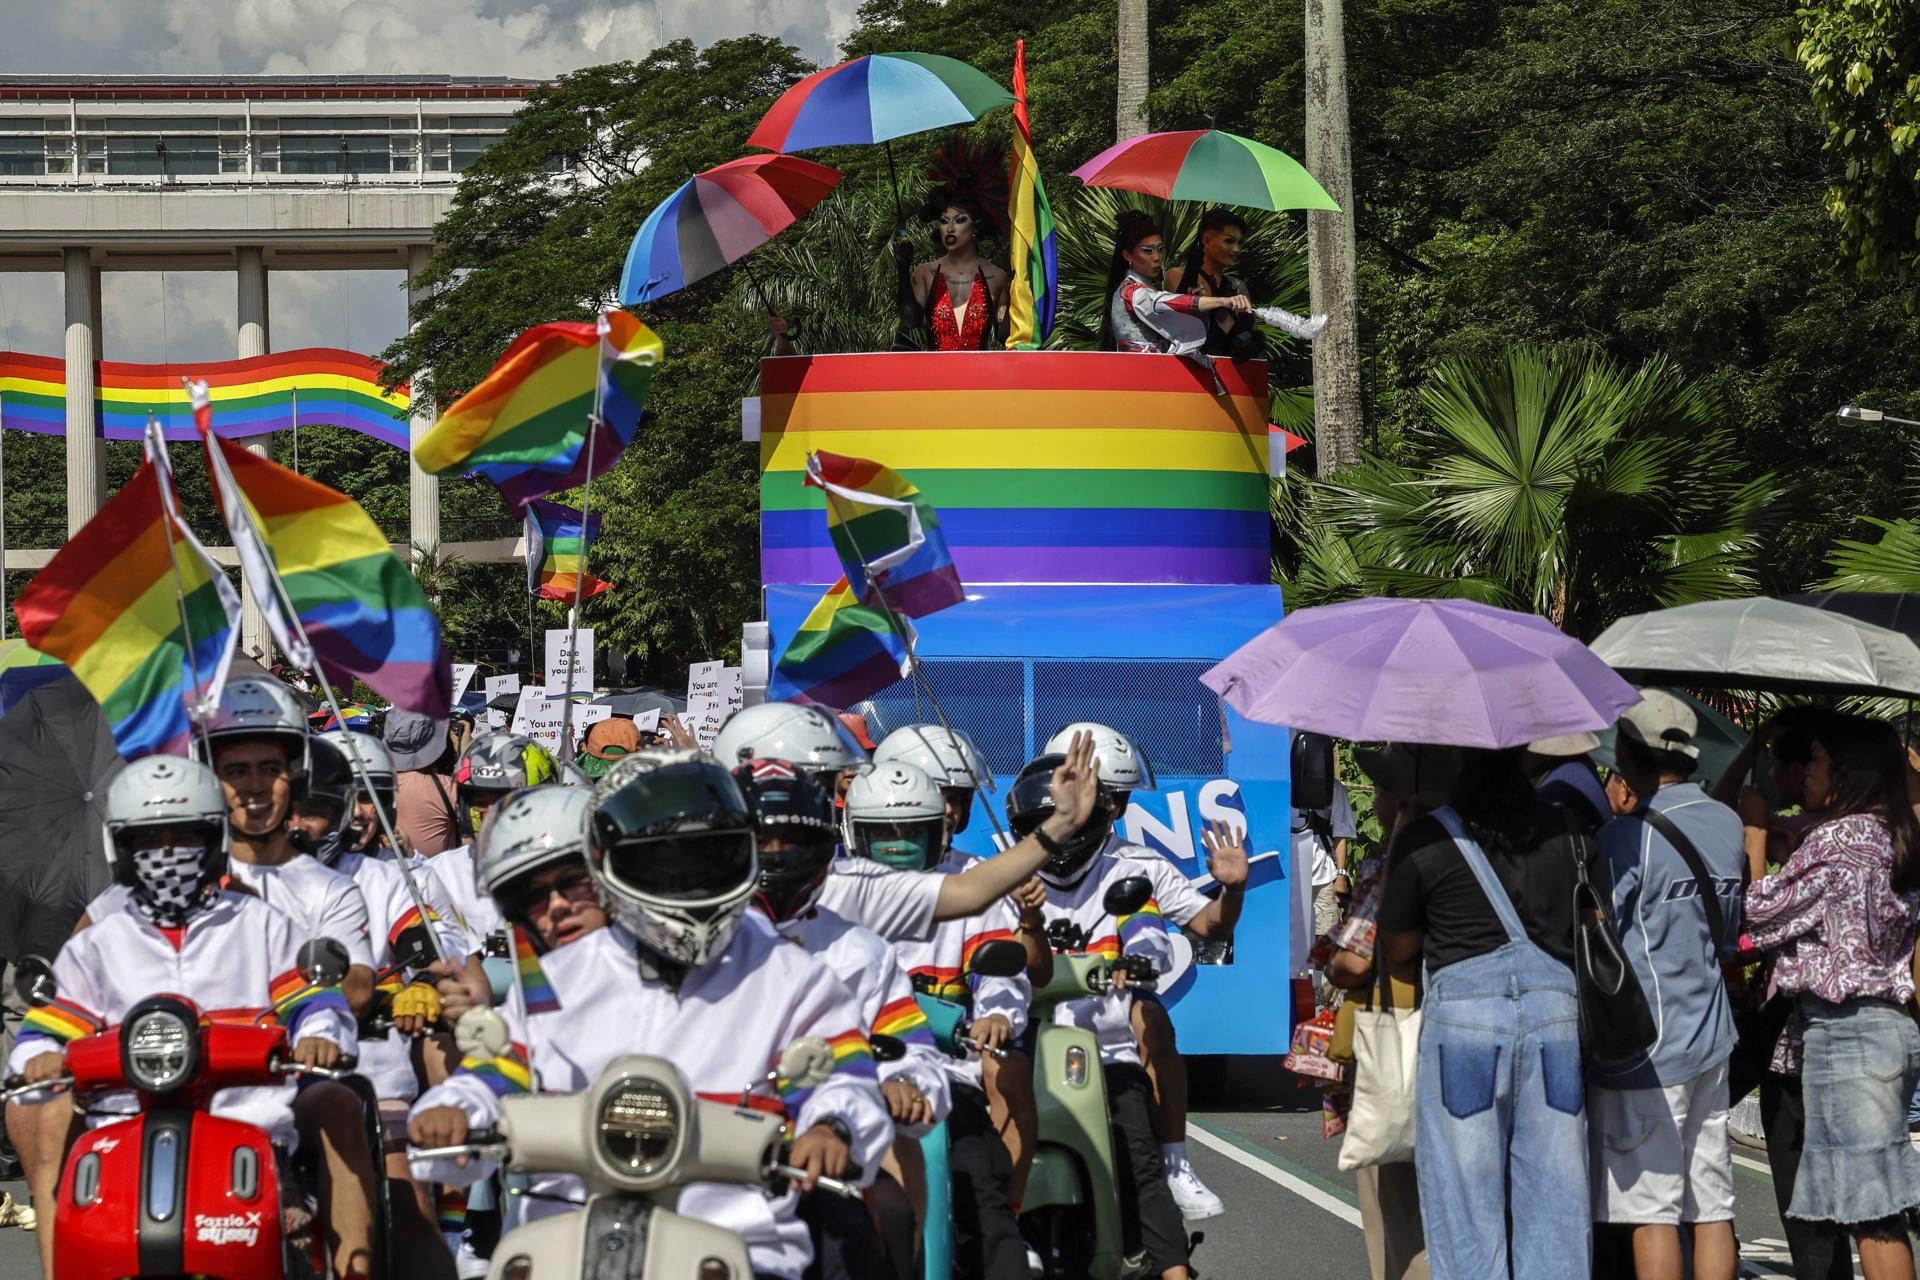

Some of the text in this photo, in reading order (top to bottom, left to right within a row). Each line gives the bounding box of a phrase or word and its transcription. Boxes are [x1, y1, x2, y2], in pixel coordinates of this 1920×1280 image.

[560, 649, 580, 657] Dae
[559, 658, 569, 666] to
[551, 666, 588, 677] youelf.
[692, 682, 706, 690] You
[529, 719, 547, 729] You
[548, 720, 563, 728] are
